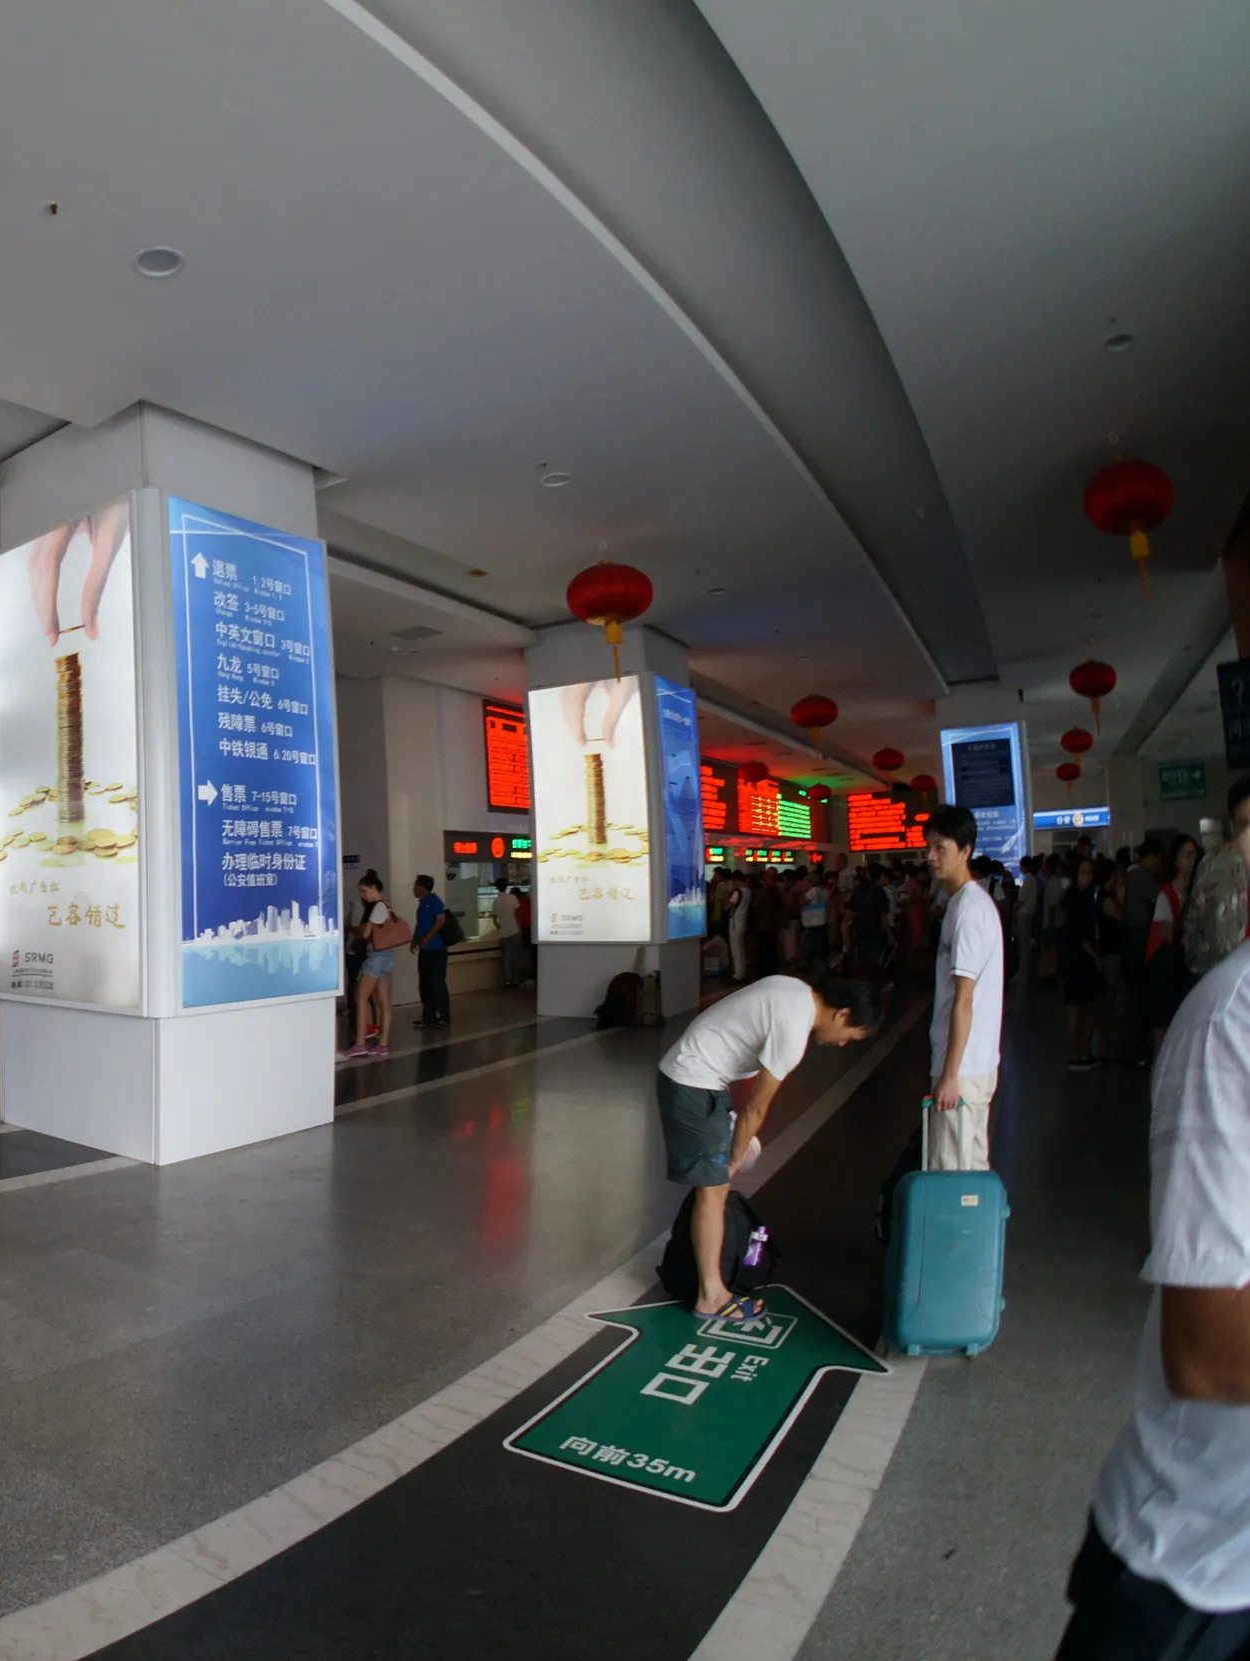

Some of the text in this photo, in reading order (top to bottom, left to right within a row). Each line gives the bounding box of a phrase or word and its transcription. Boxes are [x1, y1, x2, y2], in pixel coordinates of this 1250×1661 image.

[213, 559, 238, 581] 退票
[214, 590, 239, 612] 改签
[215, 621, 311, 657] 中英文窗口 3号窗口
[216, 652, 279, 680] 九龙 5号窗口
[216, 684, 309, 716] 挂失/公免 6号窗口
[218, 711, 293, 738] 残障票 6号窗口
[219, 737, 269, 761] 中铁银通
[221, 783, 297, 806] 售票 7-15号窗口
[222, 819, 318, 840] 无障碍售票 7号窗口
[221, 852, 307, 871] 办理临时身份证
[24, 952, 54, 964] SRMG
[639, 1343, 737, 1405] 出口
[730, 1354, 769, 1382] Exit
[558, 1435, 697, 1483] 向前35m
